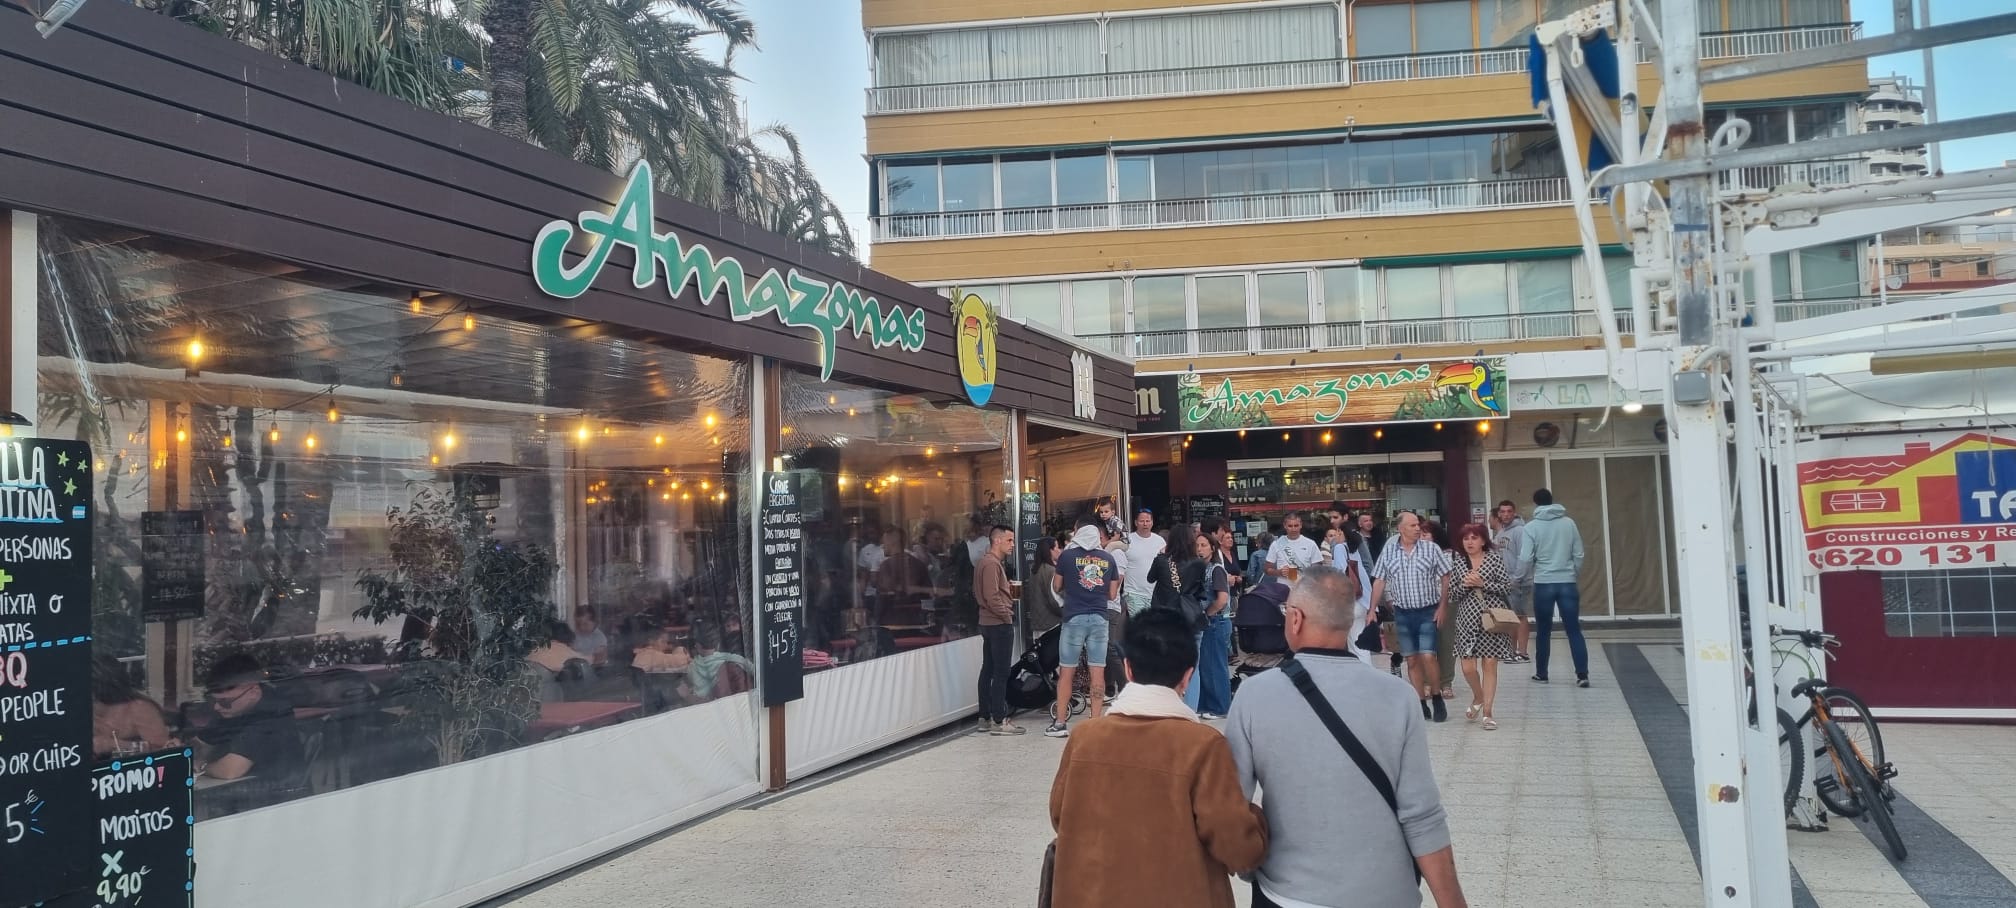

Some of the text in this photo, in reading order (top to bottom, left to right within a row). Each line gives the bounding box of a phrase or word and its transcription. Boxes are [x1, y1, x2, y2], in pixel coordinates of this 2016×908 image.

[532, 158, 925, 382] Amazonas
[1188, 364, 1430, 422] Amazonas
[1557, 383, 1592, 405] LA
[0, 487, 57, 520] TINA
[1826, 528, 1970, 543] Construcciones
[1978, 529, 1988, 541] y
[1824, 544, 1996, 566] 620 131
[1, 687, 65, 723] PEOPLE
[10, 753, 28, 775] OR
